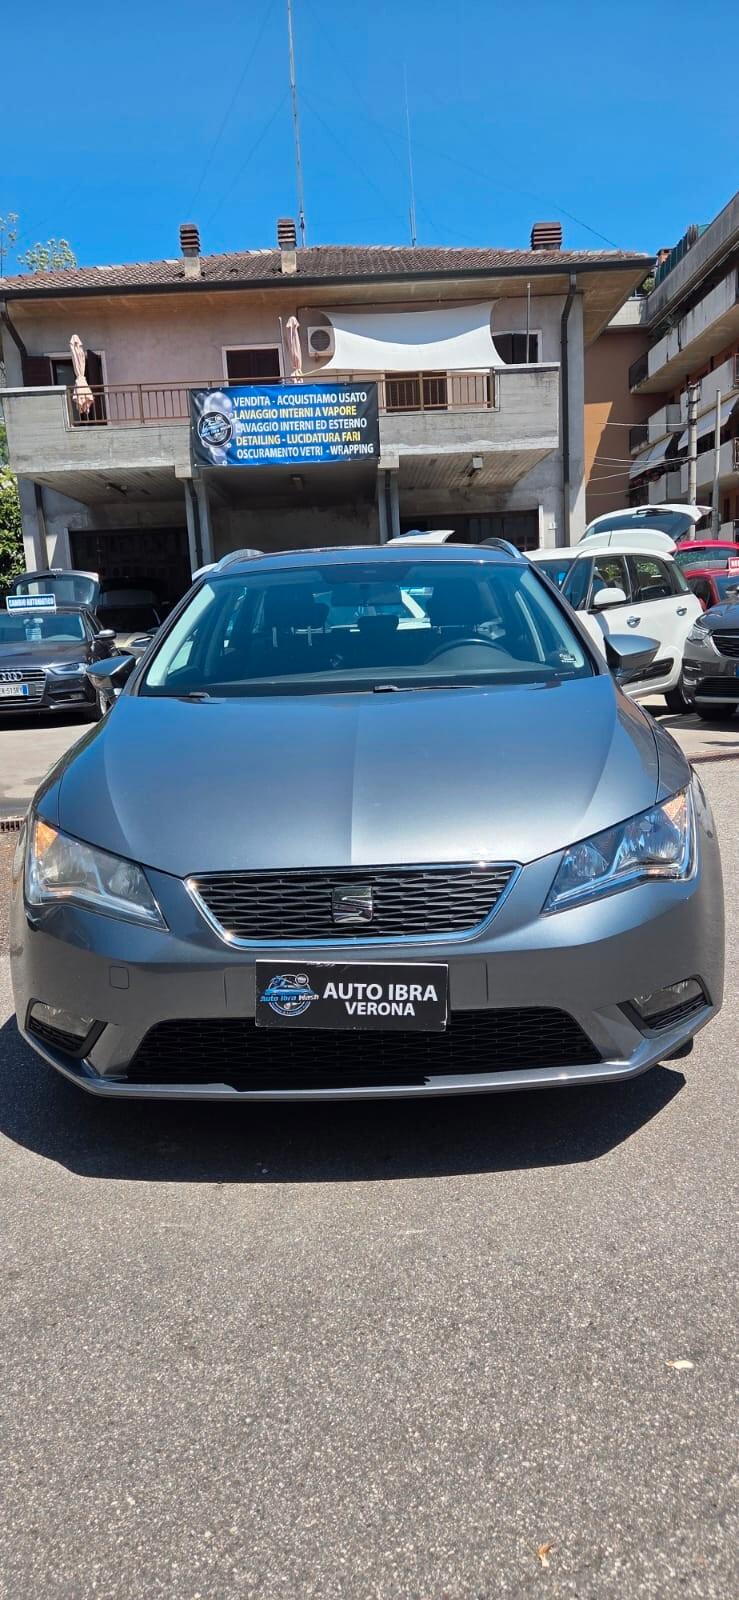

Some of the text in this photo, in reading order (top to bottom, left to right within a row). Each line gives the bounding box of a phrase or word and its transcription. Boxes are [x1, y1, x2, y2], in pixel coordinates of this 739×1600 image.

[233, 396, 270, 407] VENDITA
[277, 393, 337, 405] ACQUISTIAMO
[339, 392, 367, 403] USATO
[234, 405, 357, 420] LAVAGGIO INTERNI A VAPORE
[236, 421, 278, 433] LAVAGGIO
[280, 420, 314, 431] INTERNI
[316, 420, 327, 430] ED
[329, 418, 367, 429] ESTERNO
[236, 434, 280, 446] DETAILING
[287, 432, 340, 444] LUCIDATURA
[342, 431, 360, 442] FARI
[237, 446, 300, 459] OSCURAMENTO
[301, 446, 323, 457] VETRI
[323, 982, 438, 1001] AUTO IBRA
[345, 1001, 416, 1017] VERONA
